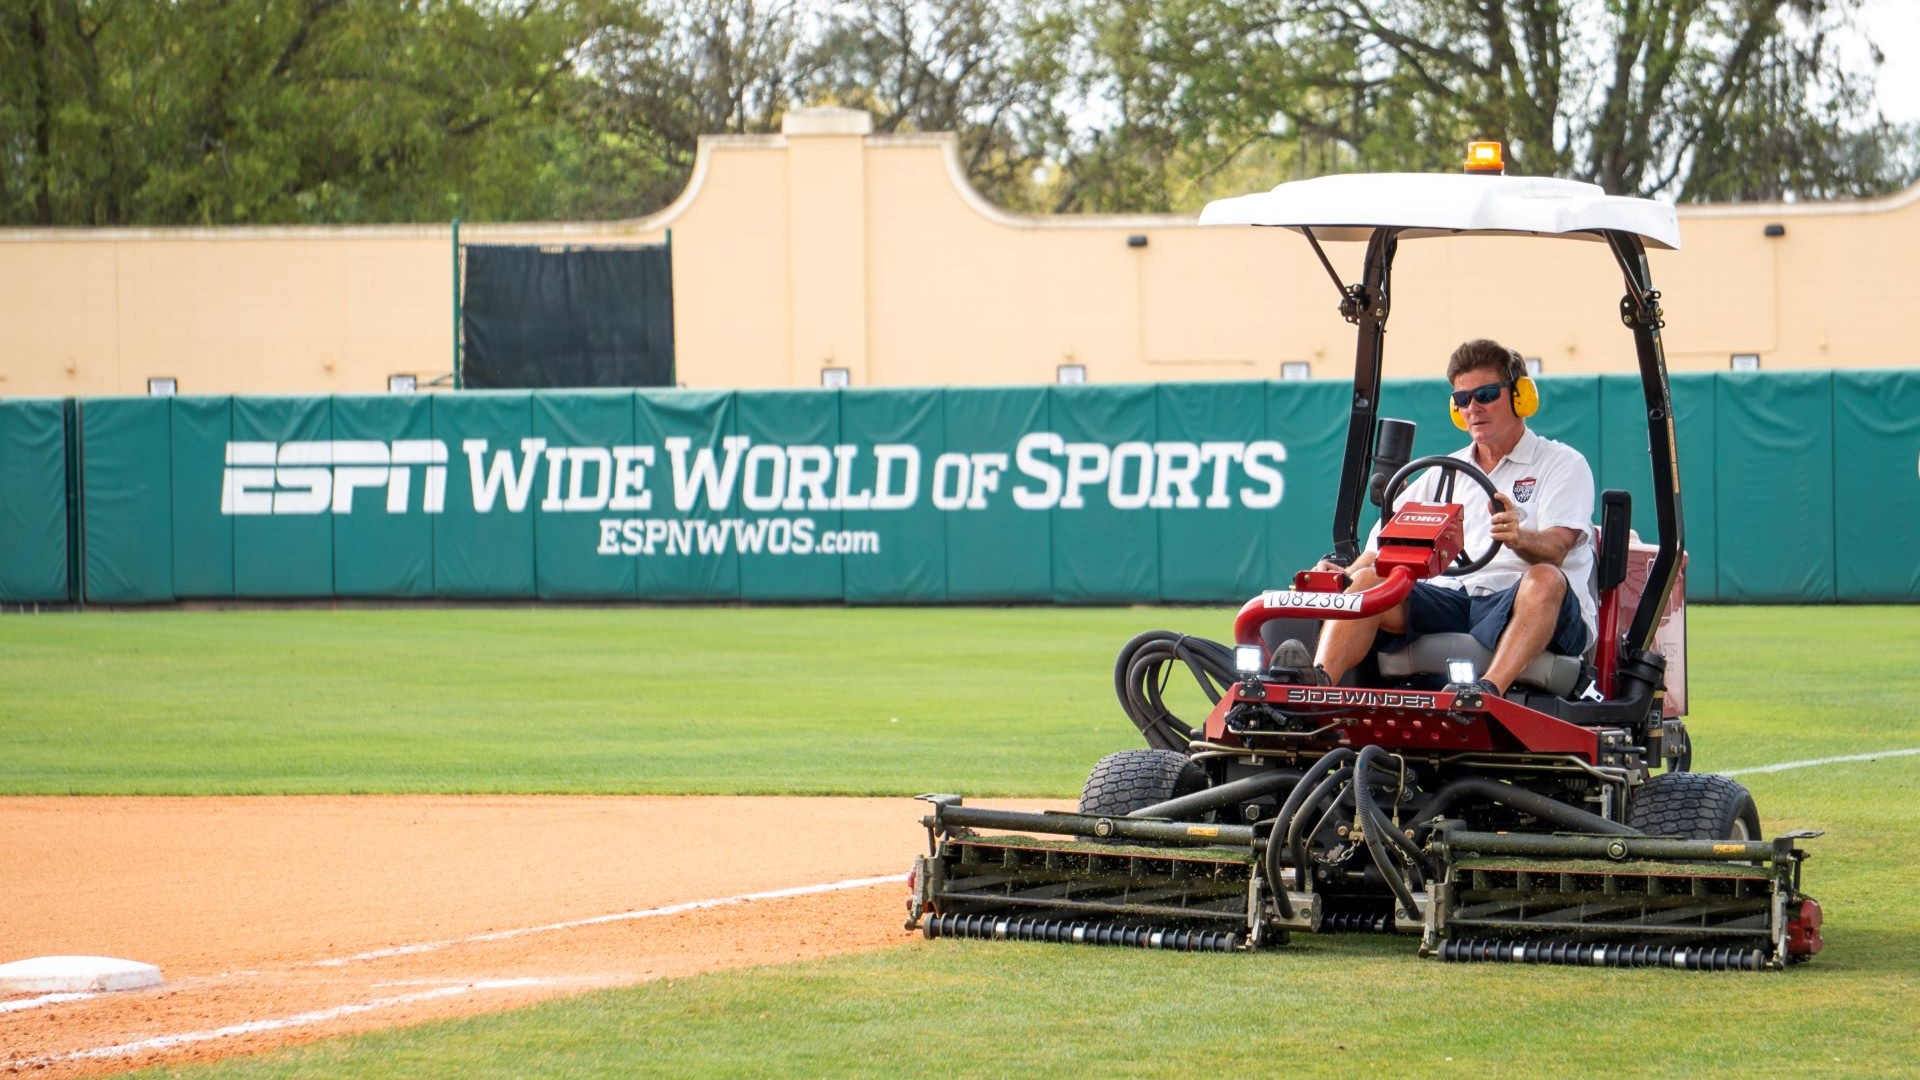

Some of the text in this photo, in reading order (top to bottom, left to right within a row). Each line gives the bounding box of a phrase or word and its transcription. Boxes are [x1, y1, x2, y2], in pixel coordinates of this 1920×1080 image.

[221, 433, 1287, 515] ESPN WIDE WORLD OF SPORTS
[1402, 515, 1442, 523] TORO
[597, 519, 880, 556] ESPNWWOS.com
[1287, 689, 1436, 709] SIDEWINDER
